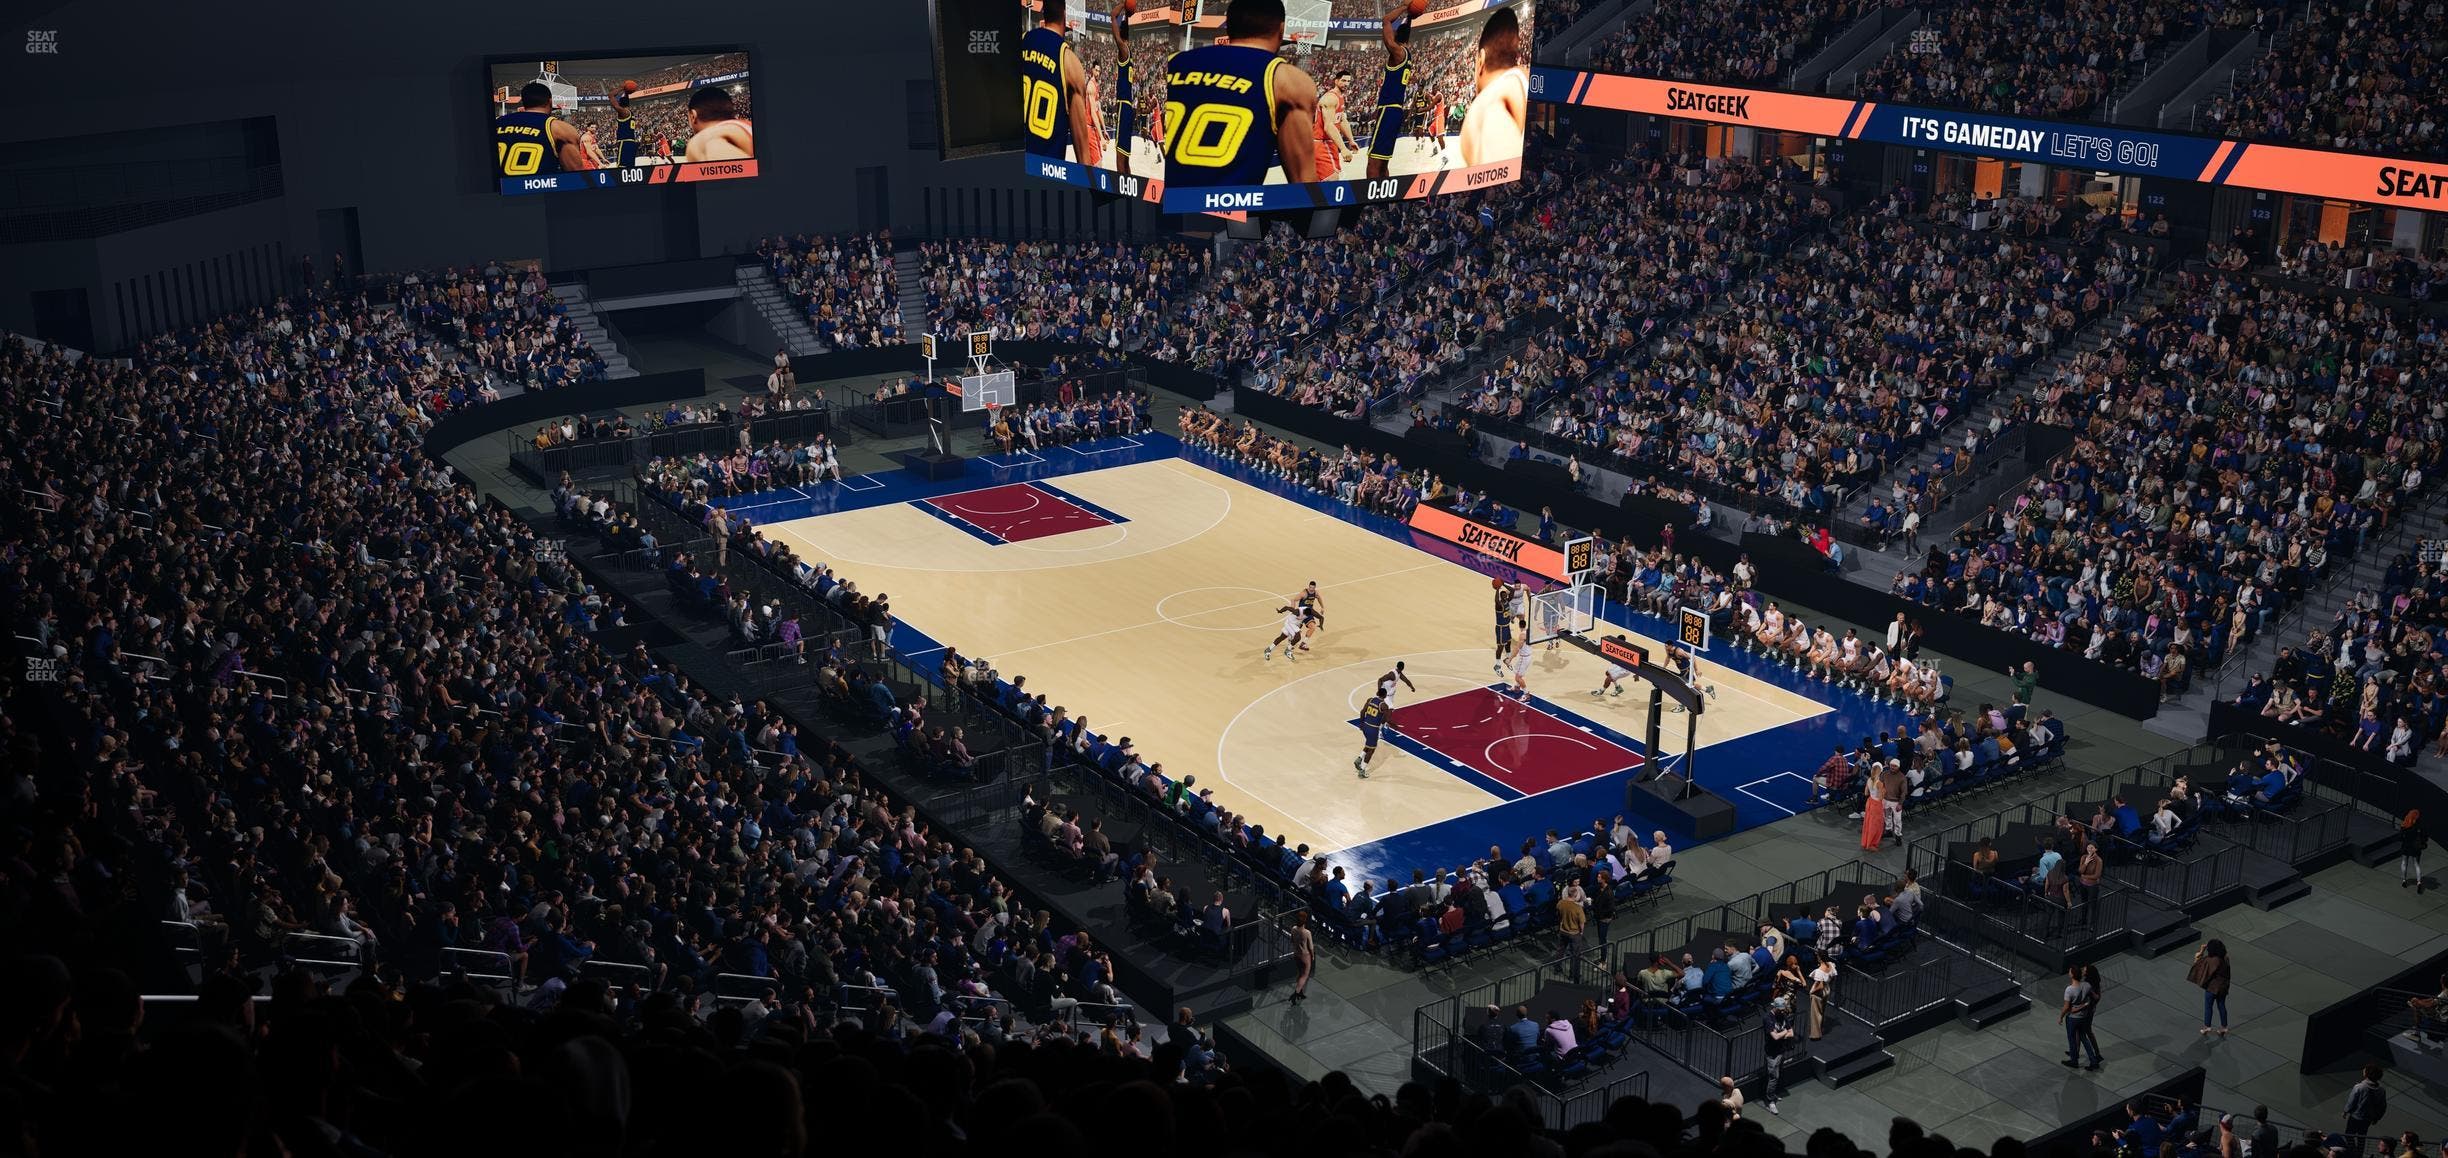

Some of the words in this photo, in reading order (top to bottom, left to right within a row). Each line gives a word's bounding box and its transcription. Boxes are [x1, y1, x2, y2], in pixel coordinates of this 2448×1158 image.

[1022, 49, 1056, 74] LAYER
[1023, 74, 1059, 140] 0
[1667, 87, 1750, 119] SEATGEEK
[1166, 101, 1254, 168] 0
[1902, 116, 1939, 141] IT'S
[1943, 121, 2045, 152] GAMEDAY
[2050, 132, 2113, 162] LET'S
[2117, 140, 2159, 167] GO!
[498, 142, 544, 176] 0
[1831, 153, 1844, 162] 121
[621, 168, 643, 183] 0:00
[700, 164, 743, 176] VISITORS
[1041, 162, 1067, 180] HOME
[1466, 166, 1509, 186] VISITORS
[1913, 164, 1928, 173] 122
[524, 178, 557, 190] HOME
[600, 172, 606, 184] 0
[1100, 174, 1106, 190] 0
[1119, 175, 1138, 198] 0:00
[1335, 186, 1344, 202] 0
[1367, 179, 1398, 200] 0:00
[1419, 179, 1426, 194] 0
[1205, 192, 1264, 208] HOME
[2147, 194, 2165, 205] 122
[2251, 209, 2271, 220] 123
[1458, 522, 1524, 563] SEATGEEK
[1570, 544, 1580, 554] 88
[1580, 542, 1590, 553] 88
[1572, 552, 1587, 569] 88
[1684, 612, 1693, 625] 88
[1693, 614, 1703, 628] 88
[1685, 625, 1700, 645] 88
[1605, 643, 1635, 662] SEATGEEK
